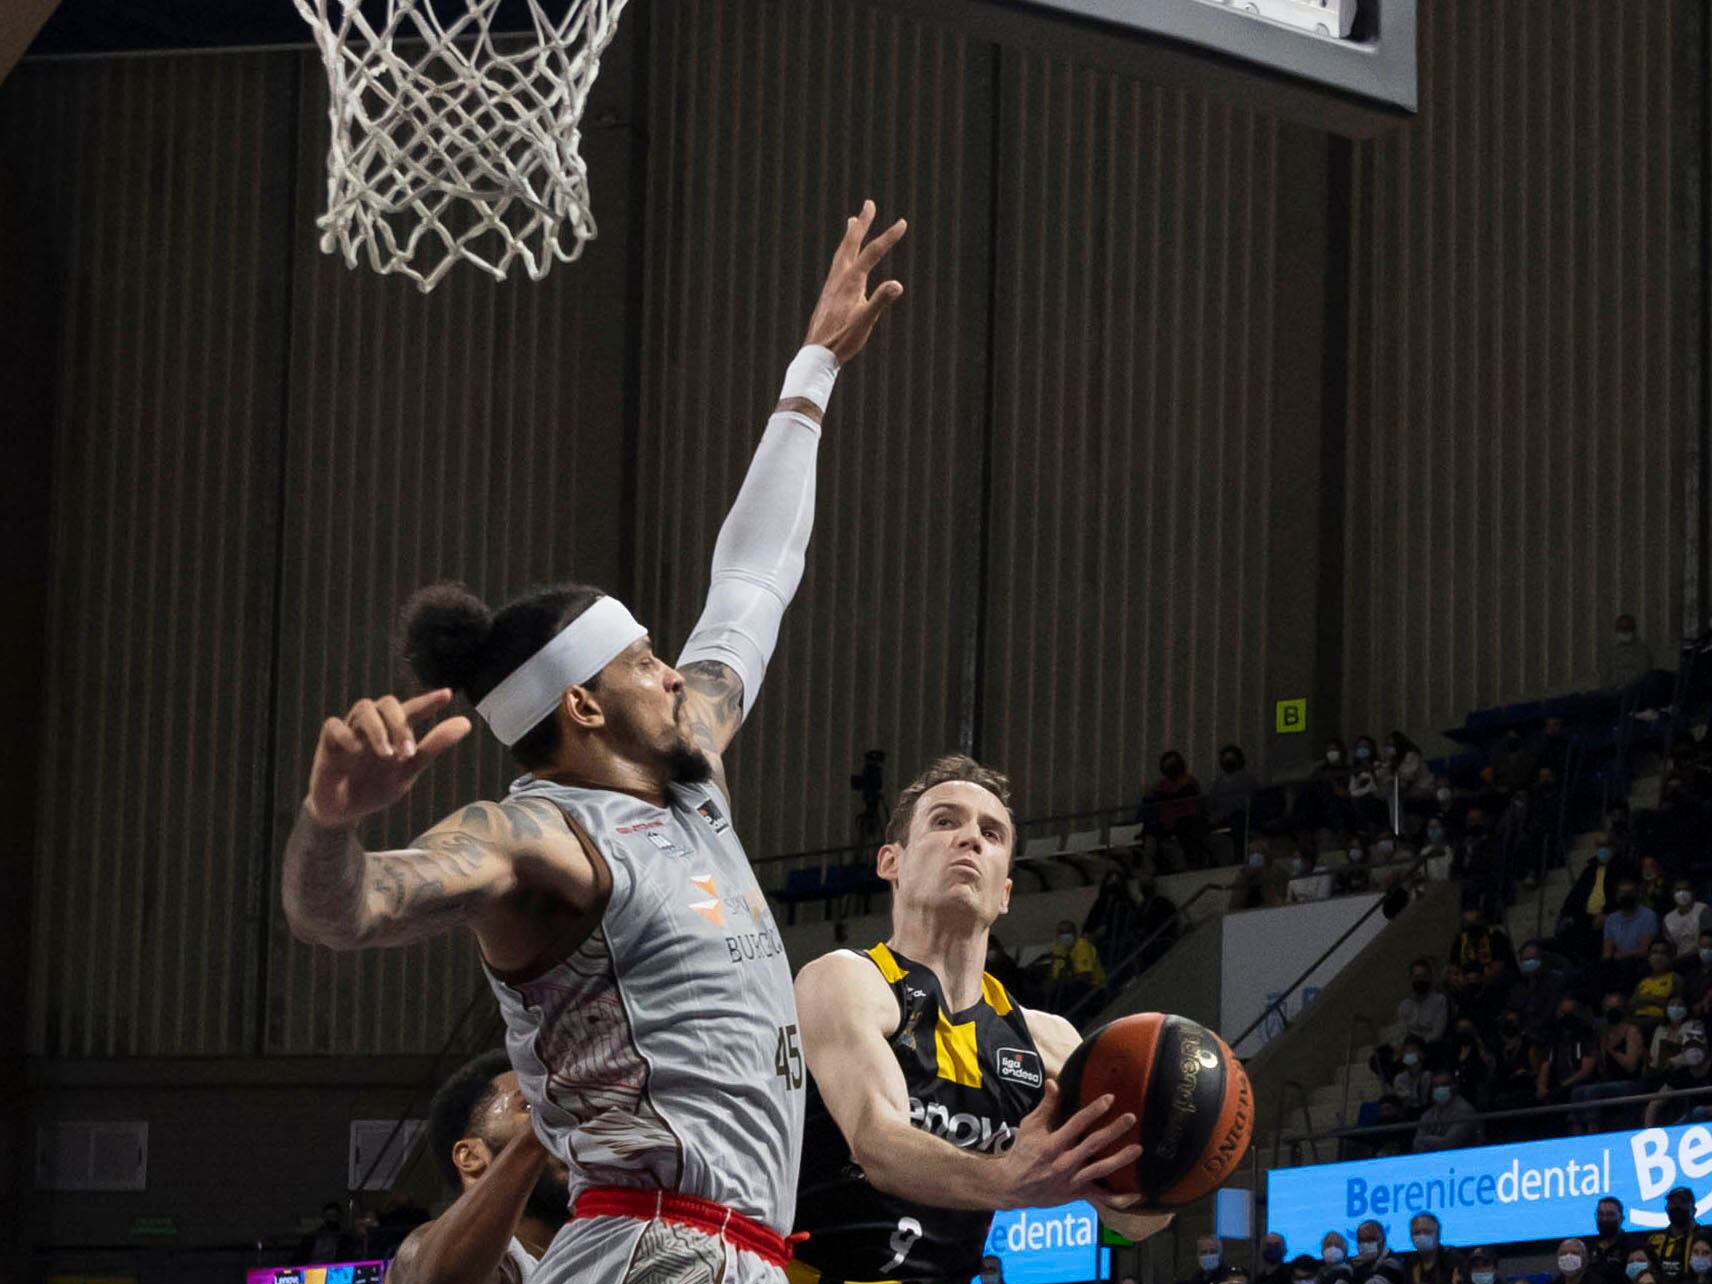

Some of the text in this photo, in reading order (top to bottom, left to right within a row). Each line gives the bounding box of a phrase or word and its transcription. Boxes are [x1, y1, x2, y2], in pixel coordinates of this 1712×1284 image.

[1283, 704, 1300, 727] B
[775, 1024, 803, 1091] 45
[1002, 1056, 1021, 1069] liga
[1002, 1066, 1039, 1083] endesa
